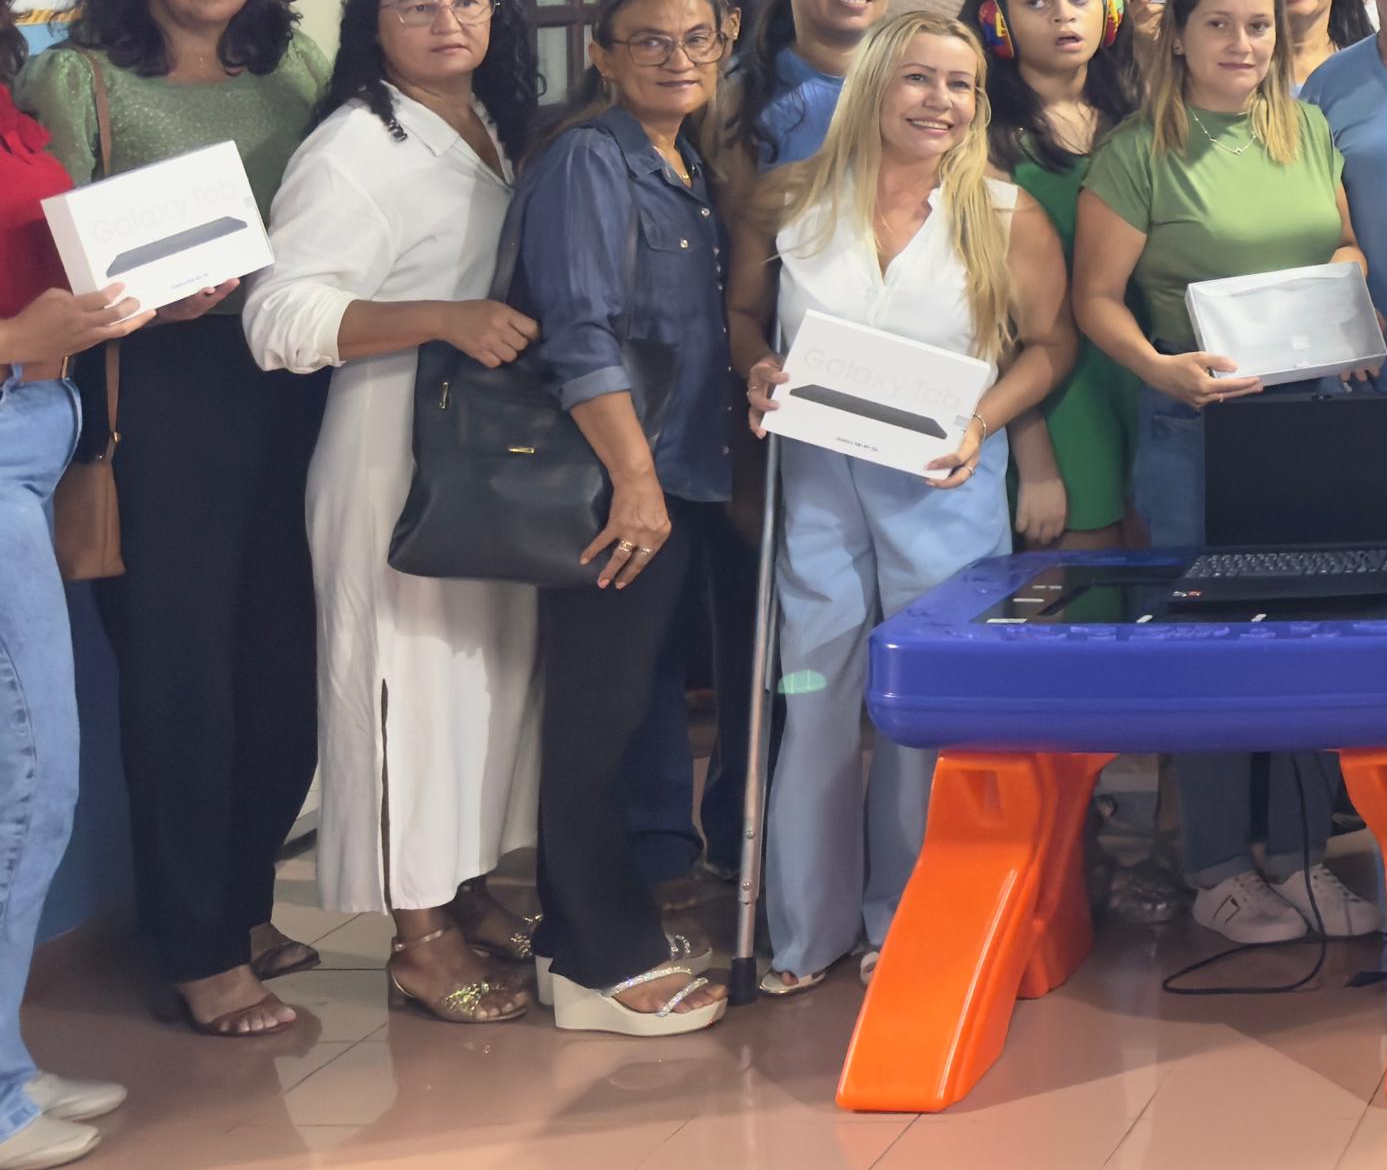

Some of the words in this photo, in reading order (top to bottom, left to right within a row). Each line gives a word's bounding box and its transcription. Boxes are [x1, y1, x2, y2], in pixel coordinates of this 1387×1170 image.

[94, 200, 186, 243] Galaxy
[187, 178, 238, 207] Tab
[803, 347, 905, 393] Galaxy
[910, 377, 962, 411] Tab
